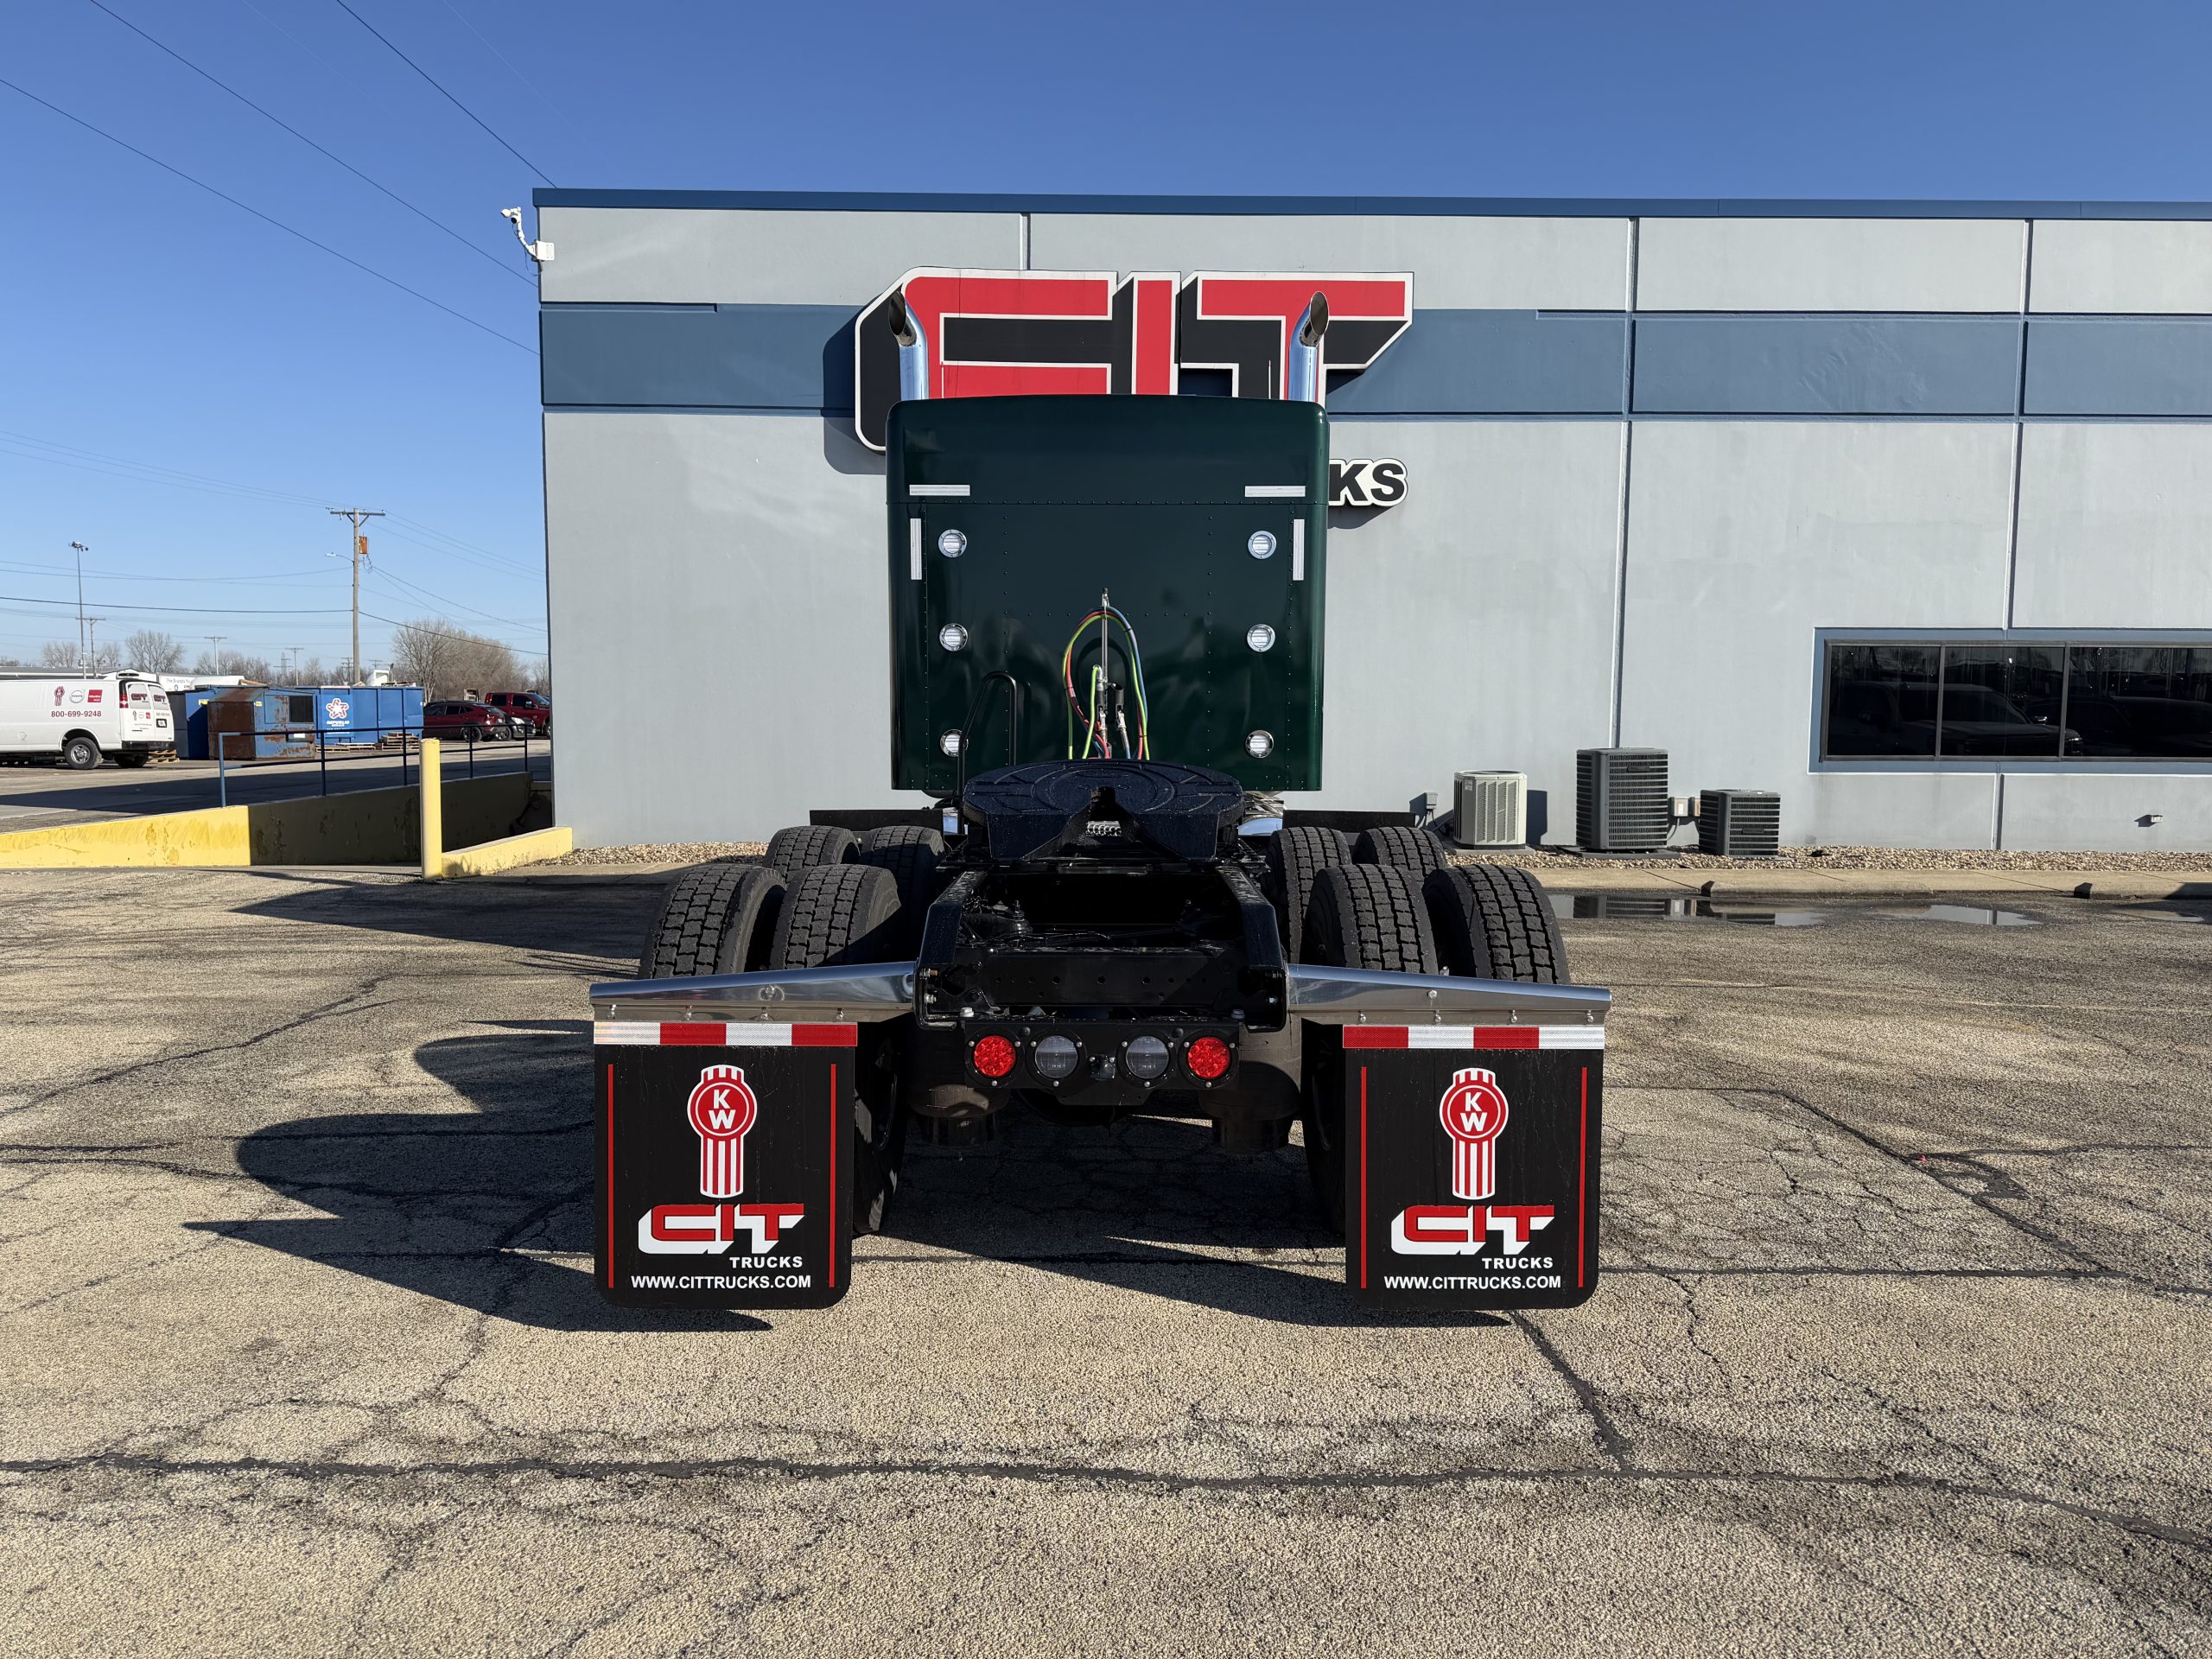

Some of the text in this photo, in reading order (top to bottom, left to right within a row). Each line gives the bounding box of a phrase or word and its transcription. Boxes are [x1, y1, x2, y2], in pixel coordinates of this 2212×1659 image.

[713, 1089, 730, 1109] K
[1465, 1092, 1482, 1111] K
[708, 1109, 736, 1129] W
[1459, 1112, 1488, 1132] W
[639, 1204, 804, 1254] CIT
[1391, 1205, 1554, 1255] CIT
[729, 1256, 802, 1268] TRUCKS
[1482, 1257, 1553, 1268] TRUCKS
[631, 1275, 810, 1288] WWW.CITTRUCKS.COM
[1384, 1276, 1560, 1289] WWW.CITTRUCKS.COM
